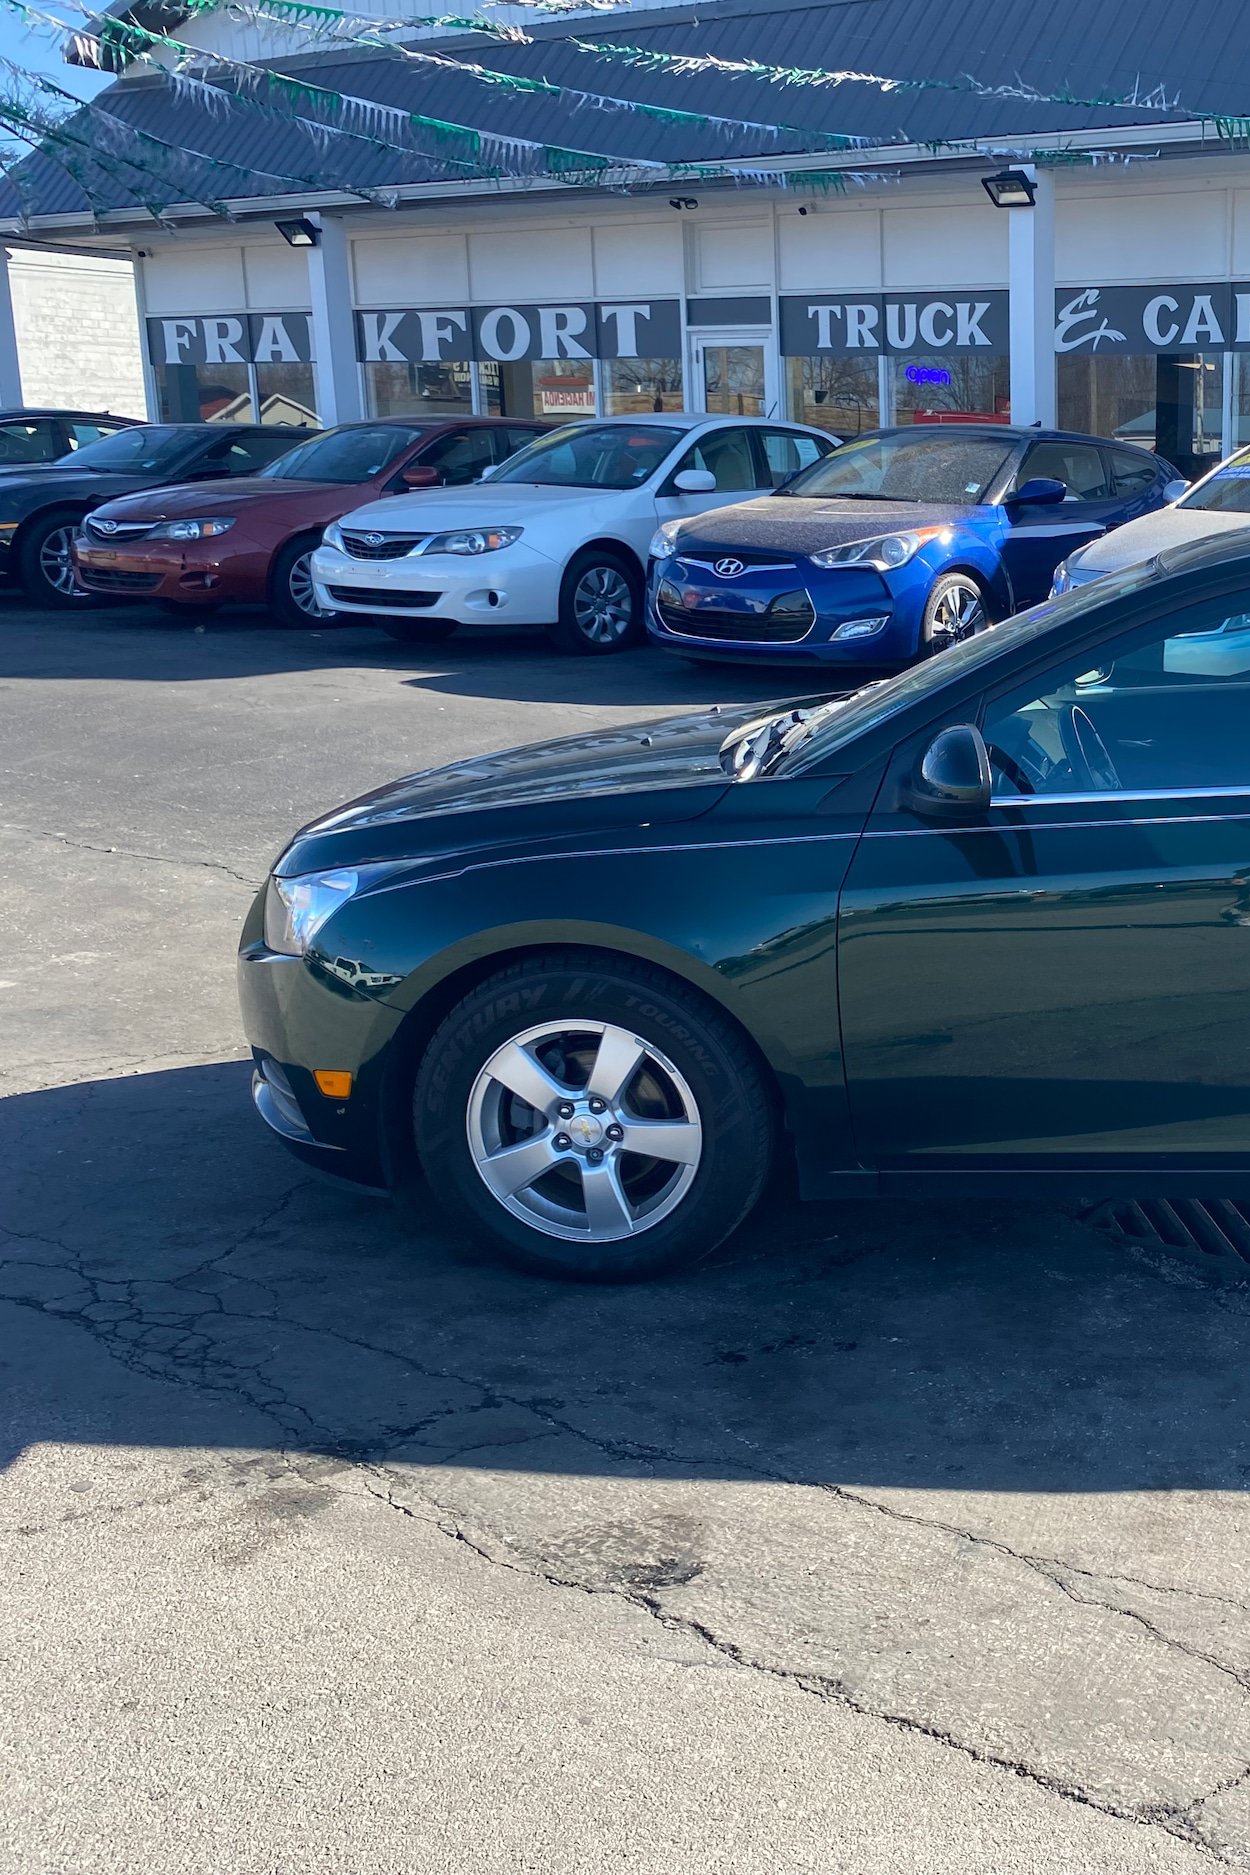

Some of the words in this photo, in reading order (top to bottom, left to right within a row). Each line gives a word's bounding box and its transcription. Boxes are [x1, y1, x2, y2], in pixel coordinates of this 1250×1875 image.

[162, 304, 651, 365] FRAKFORT
[807, 301, 993, 349] TRUCK
[1054, 288, 1127, 353] &
[905, 365, 951, 386] open
[426, 983, 548, 1112] SENTURY
[624, 994, 721, 1077] TOURING
